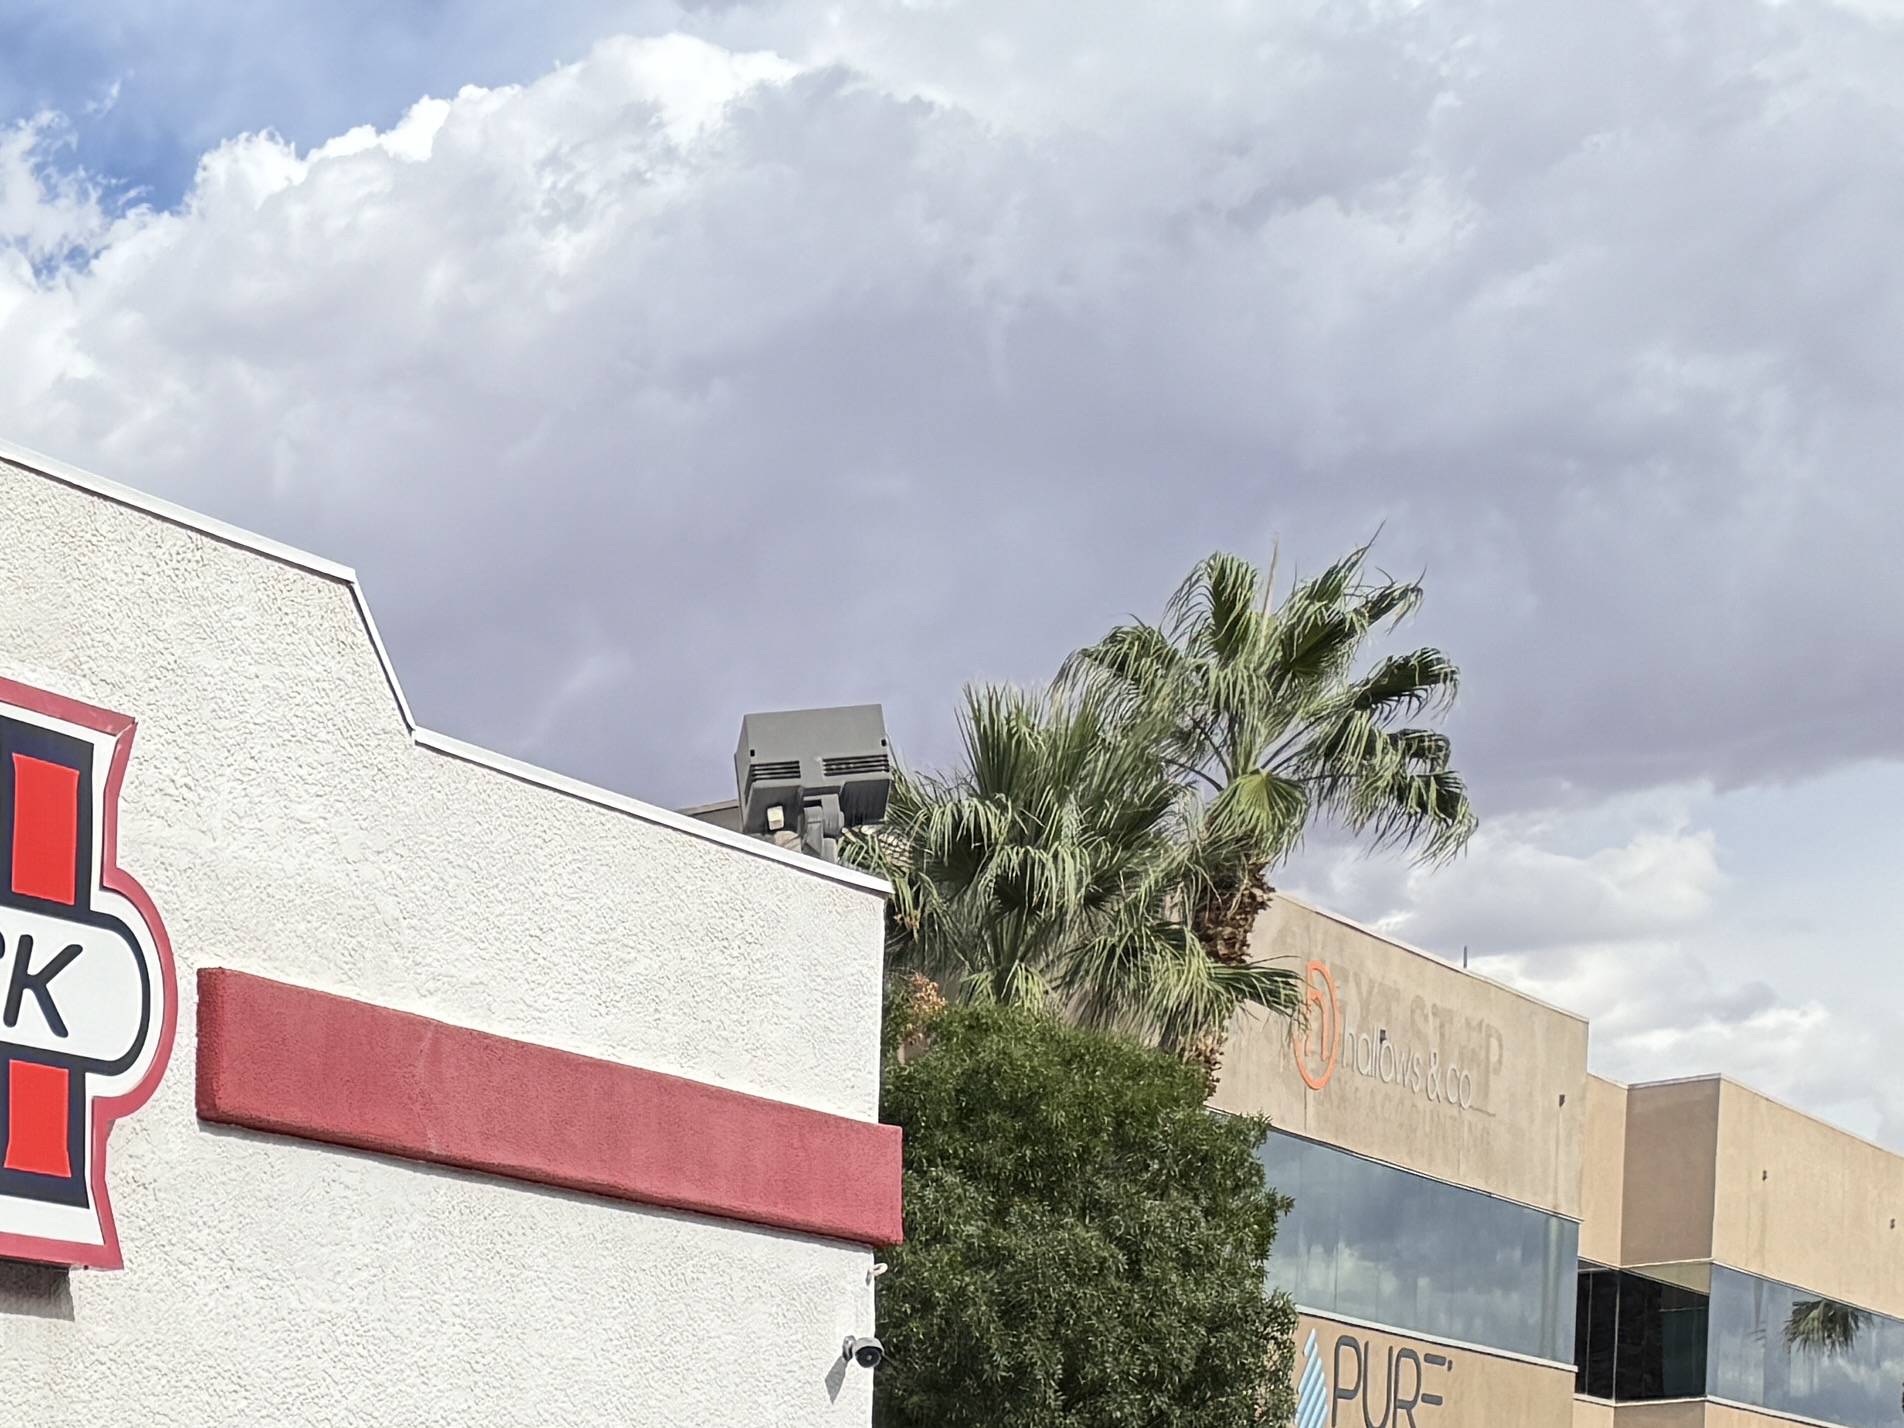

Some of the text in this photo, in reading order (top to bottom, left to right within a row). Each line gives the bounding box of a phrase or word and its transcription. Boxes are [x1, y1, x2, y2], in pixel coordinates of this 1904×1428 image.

[1342, 1025, 1473, 1110] hallows & co
